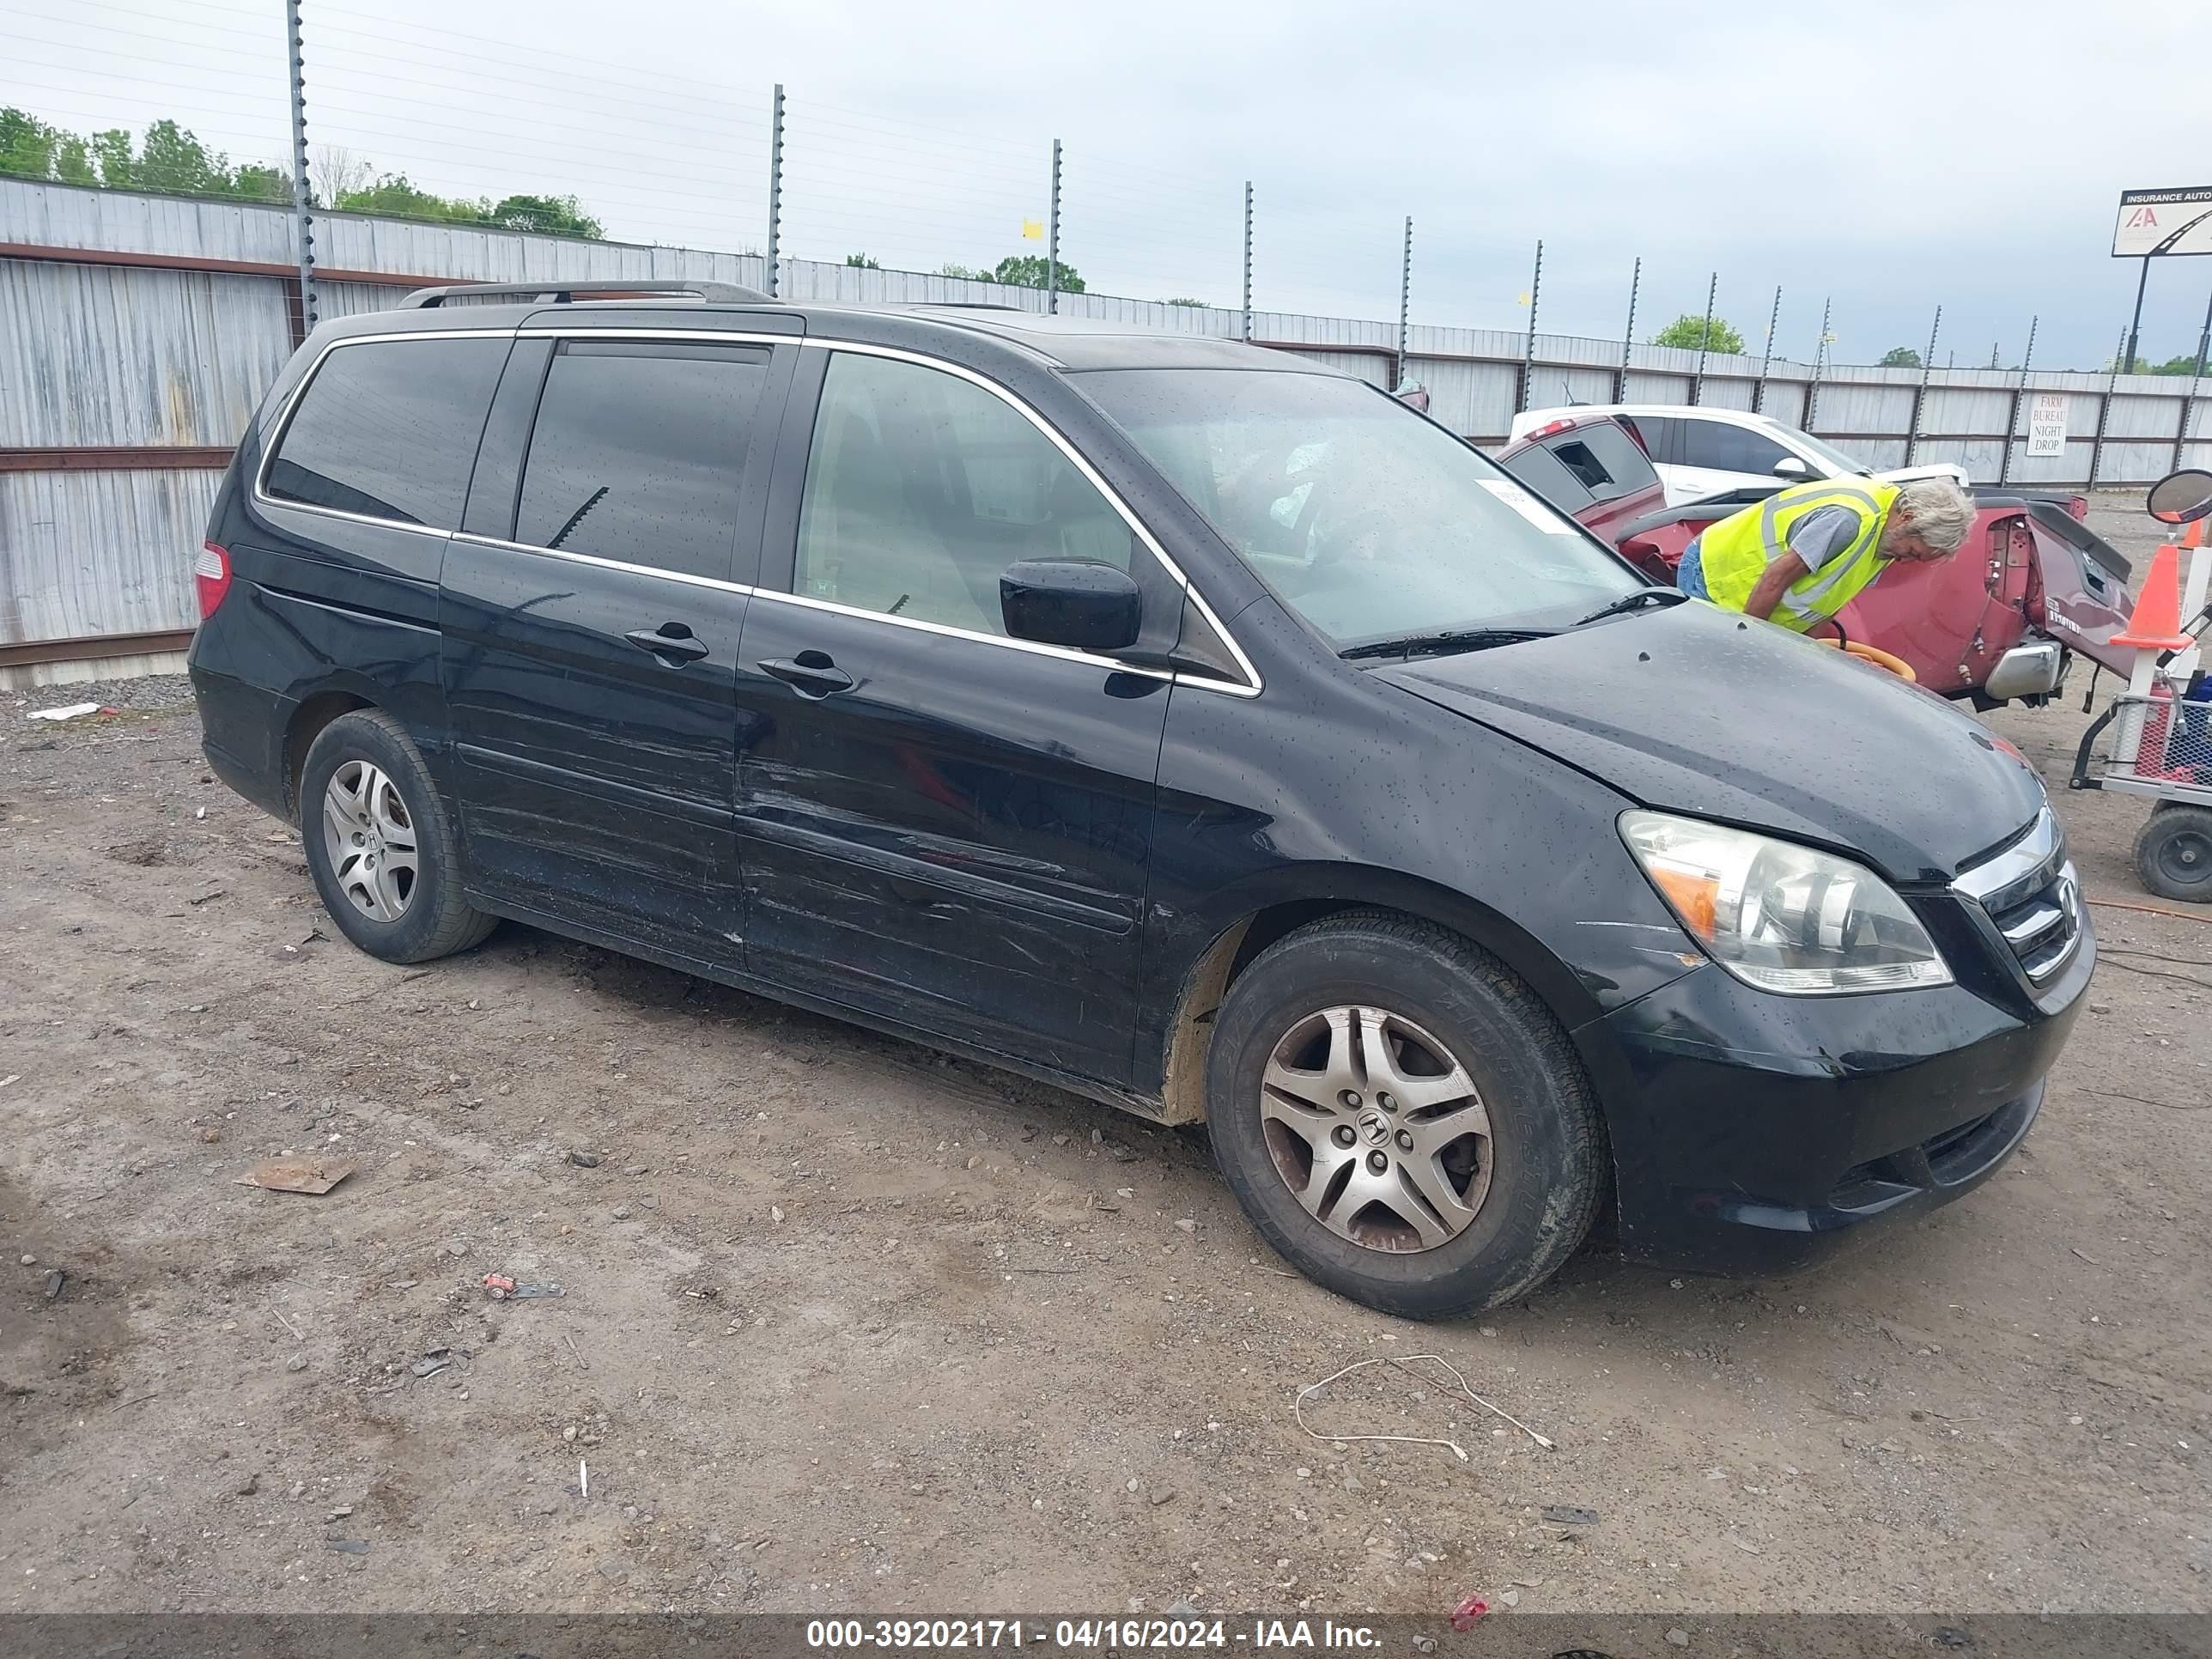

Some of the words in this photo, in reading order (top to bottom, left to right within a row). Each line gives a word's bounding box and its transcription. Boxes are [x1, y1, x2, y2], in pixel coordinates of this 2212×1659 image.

[2127, 193, 2182, 204] INSURANCE
[2185, 191, 2212, 201] AUTO
[2041, 397, 2063, 408] FARM
[2033, 410, 2067, 422] BUREAU
[2035, 426, 2062, 437] NIGHT
[2035, 440, 2059, 451] DROP
